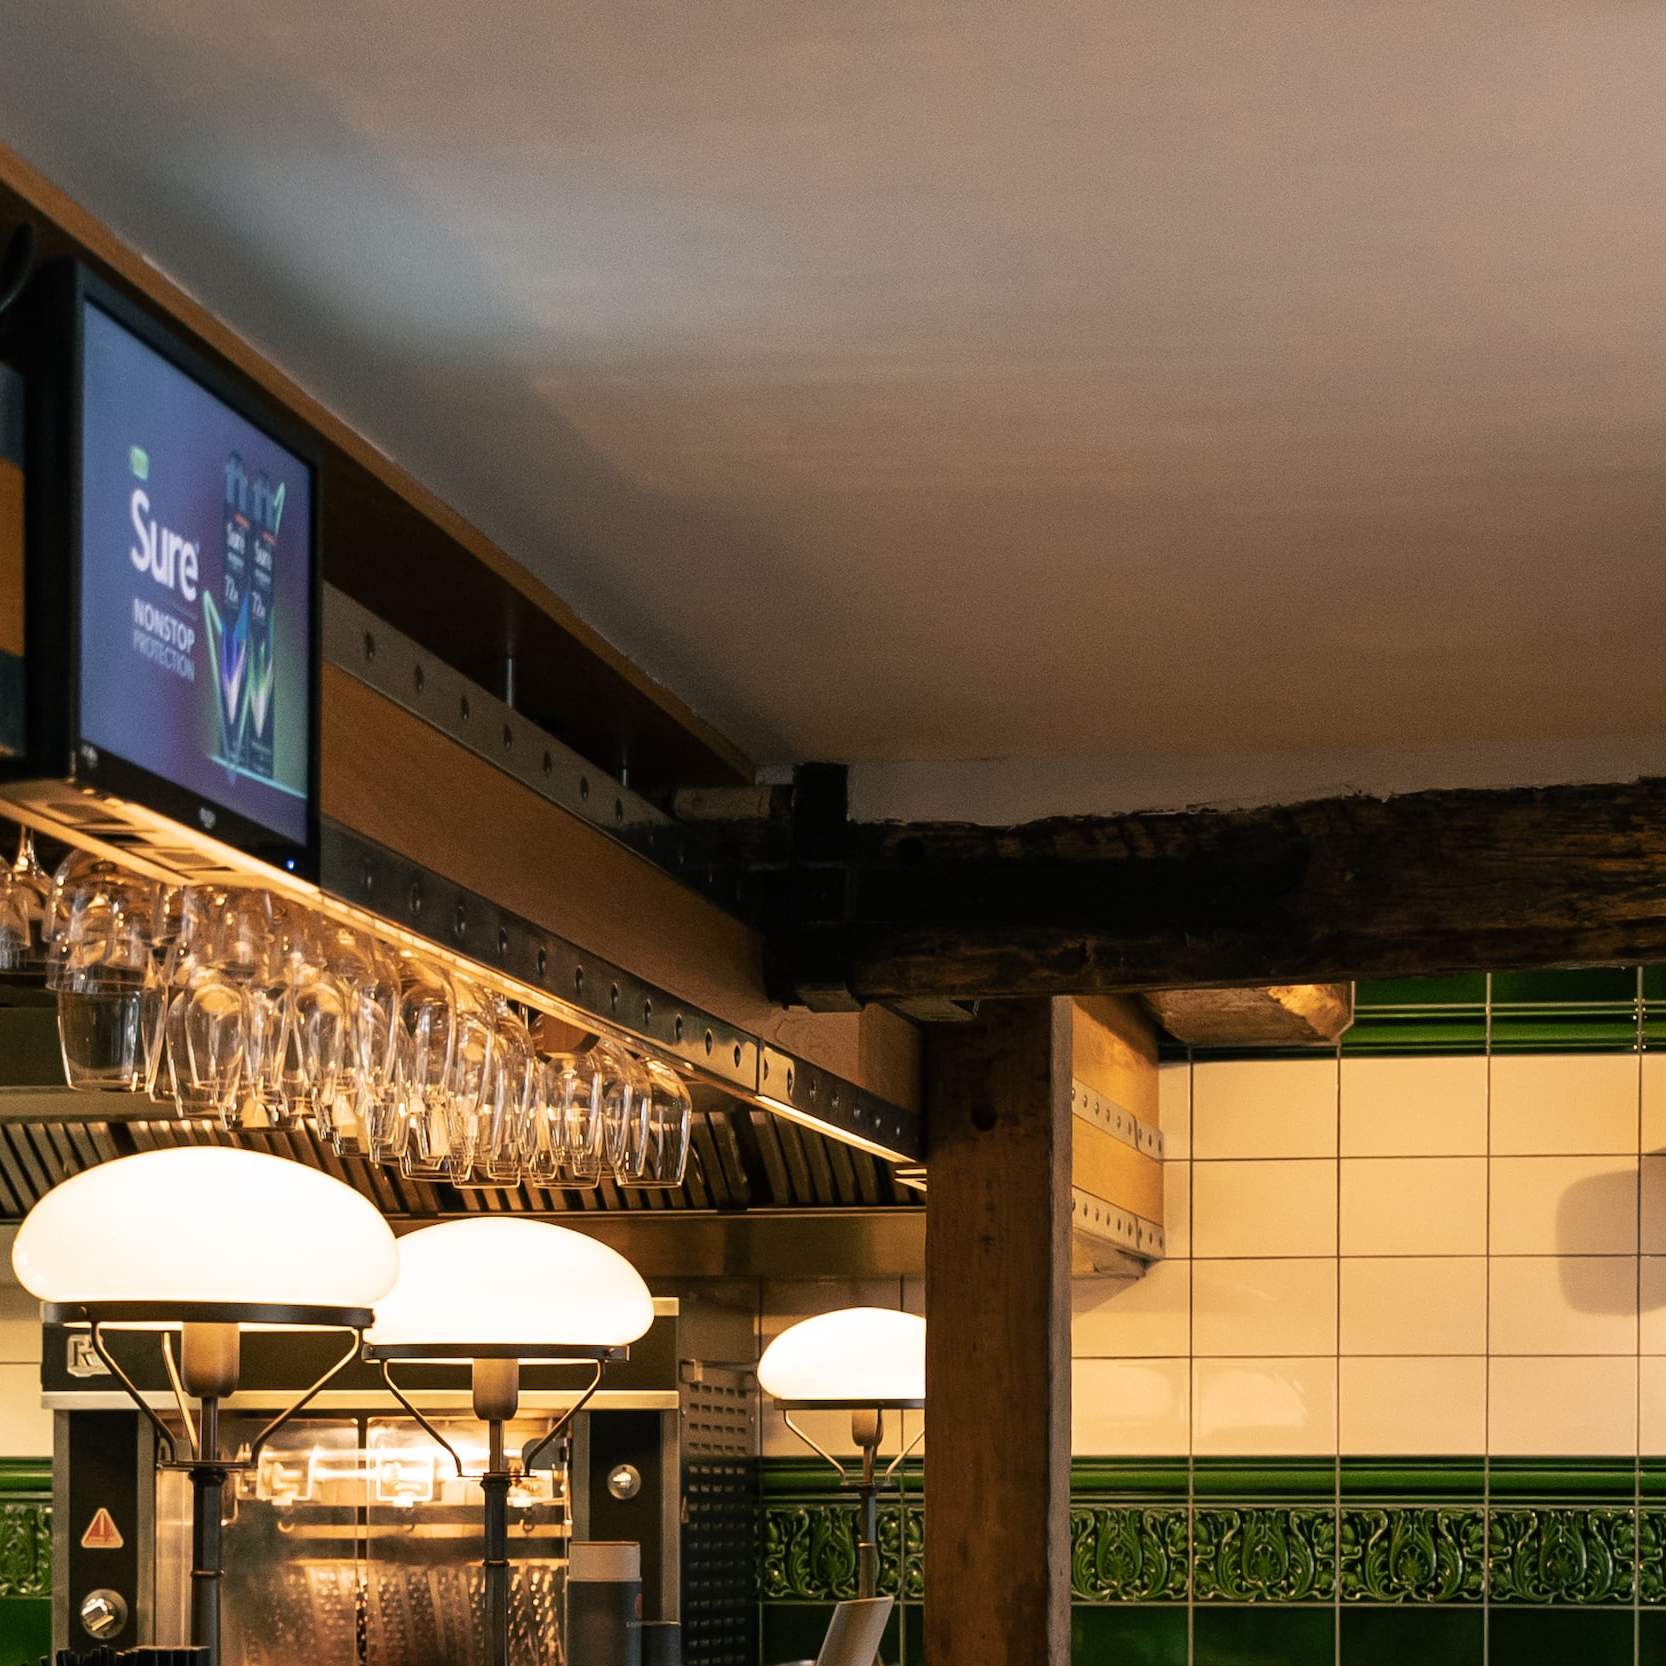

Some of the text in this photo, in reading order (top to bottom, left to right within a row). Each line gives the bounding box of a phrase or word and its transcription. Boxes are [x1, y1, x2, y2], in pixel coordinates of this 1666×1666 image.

[132, 489, 199, 602] Sure
[134, 597, 195, 653] NONSTOP
[133, 628, 195, 682] PROTECTION
